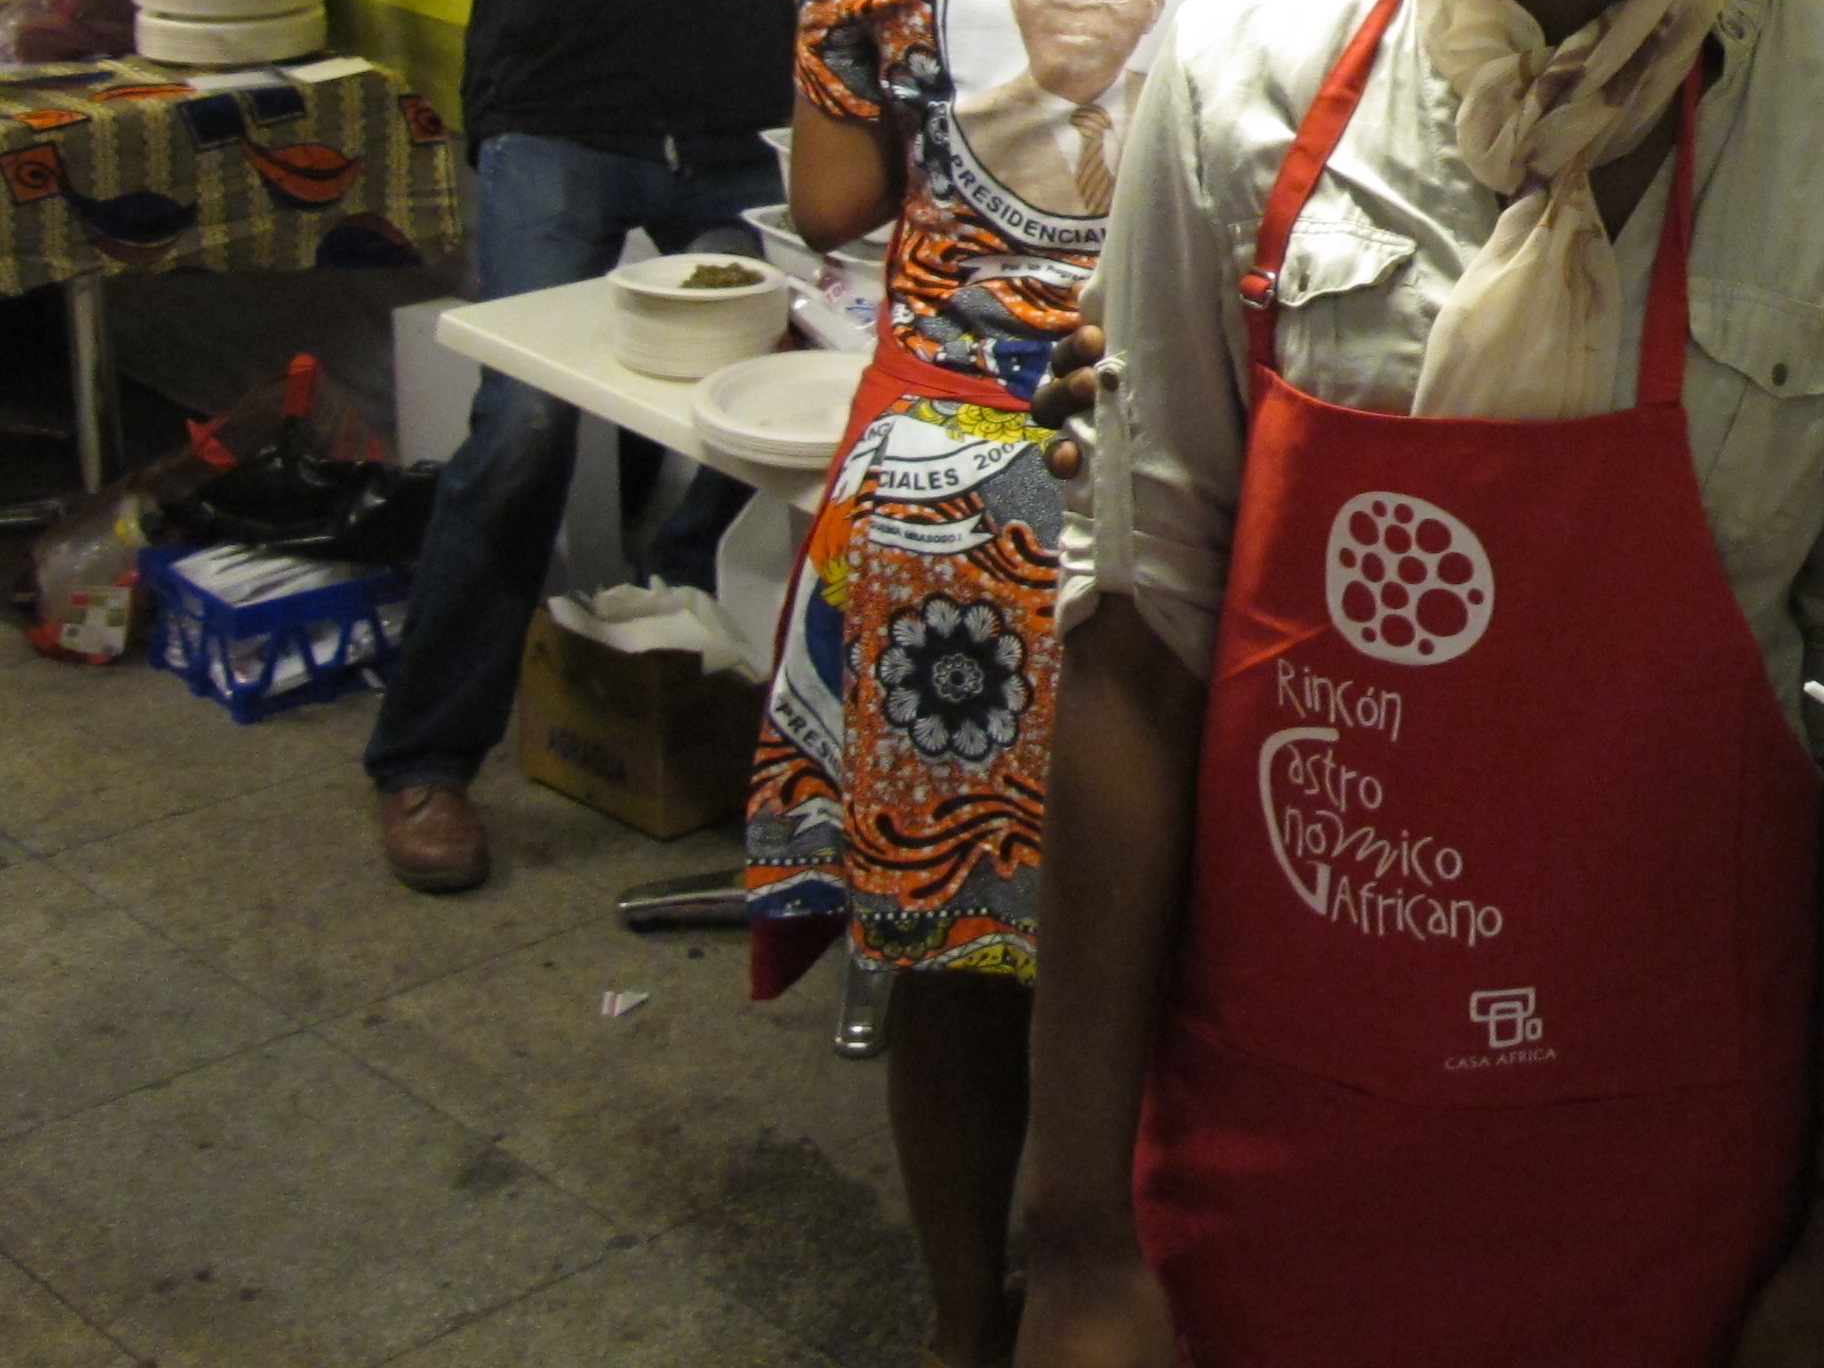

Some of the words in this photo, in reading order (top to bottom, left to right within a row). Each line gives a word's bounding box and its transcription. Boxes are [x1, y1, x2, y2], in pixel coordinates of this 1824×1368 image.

[1277, 657, 1402, 742] Rincón
[1330, 875, 1503, 947] Africano
[1443, 1055, 1491, 1071] CASA
[1494, 1047, 1558, 1067] AFRICA
